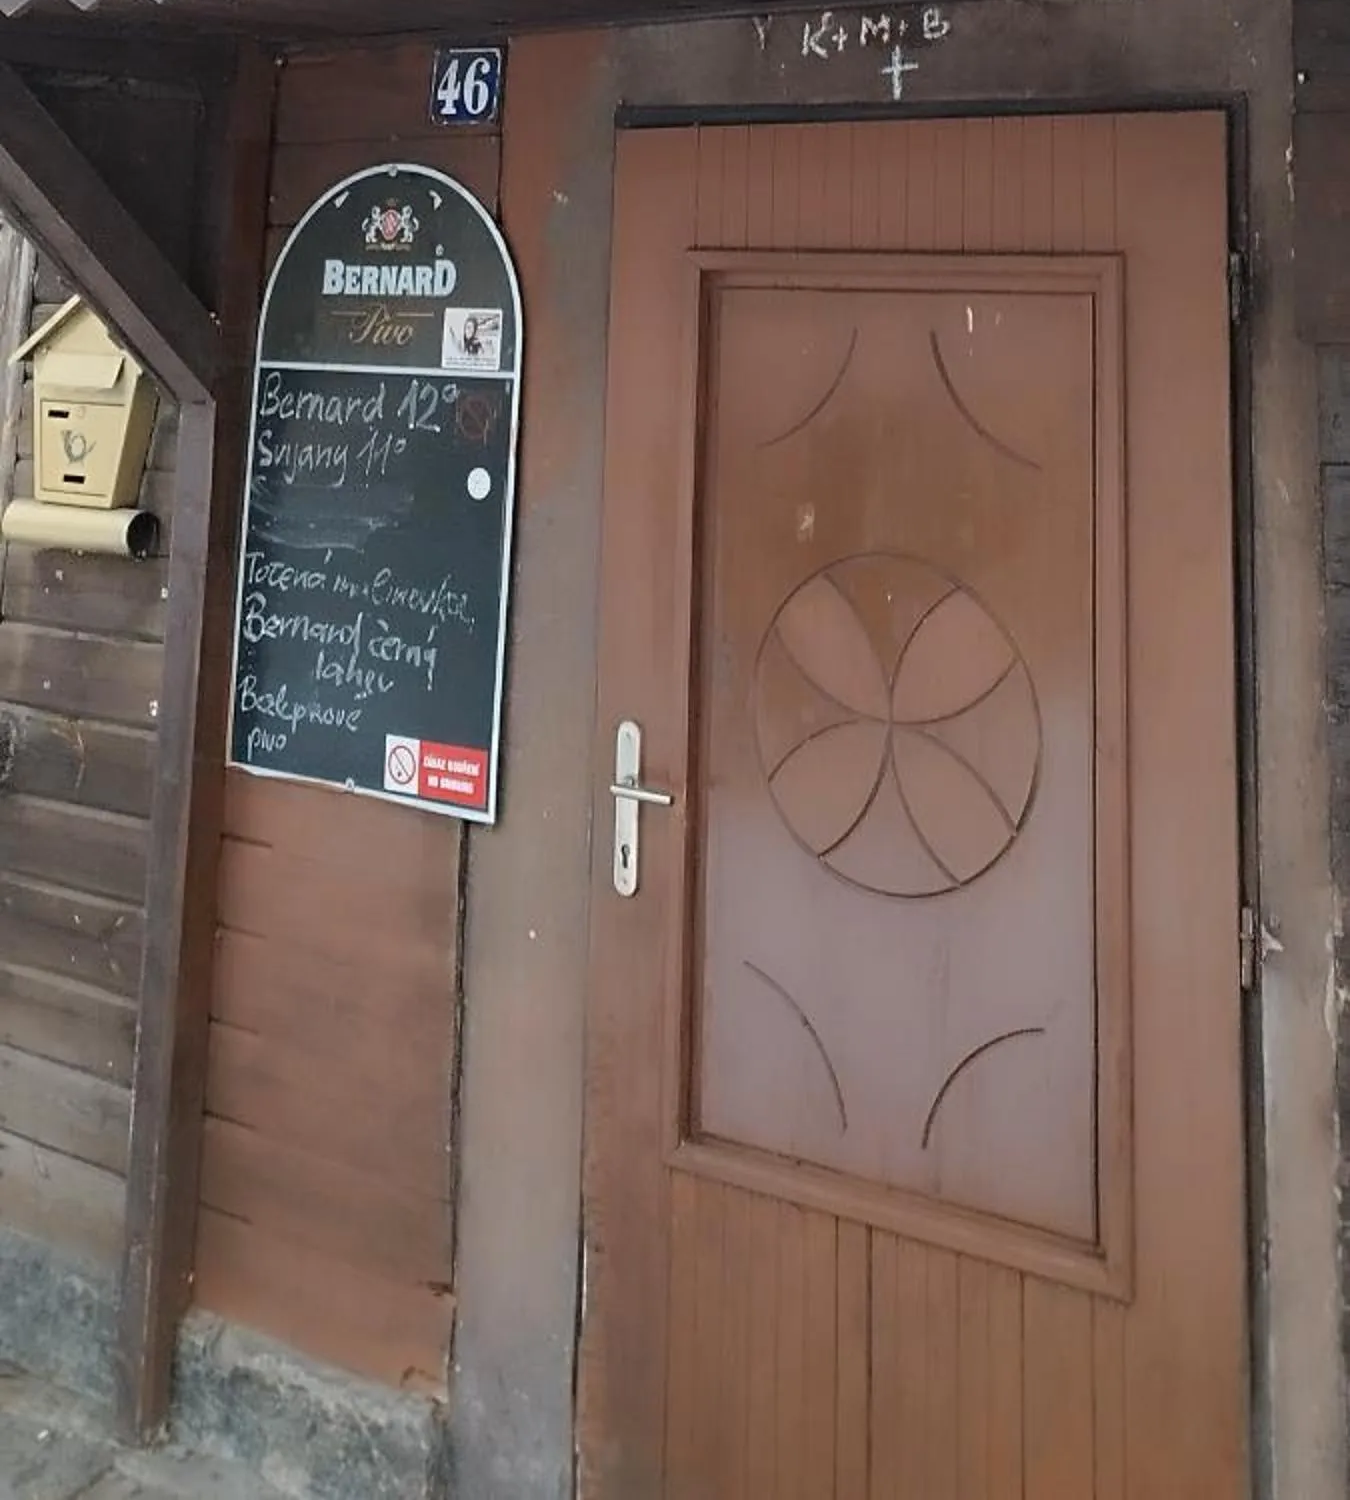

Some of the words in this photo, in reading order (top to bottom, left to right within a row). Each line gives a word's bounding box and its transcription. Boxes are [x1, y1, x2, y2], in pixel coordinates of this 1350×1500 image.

[437, 56, 490, 116] 46
[322, 257, 457, 297] BERNARD
[348, 304, 415, 346] Pivo
[259, 371, 385, 426] Bernard
[243, 592, 364, 656] Bernard
[367, 618, 438, 692] černý
[247, 727, 288, 762] pivo
